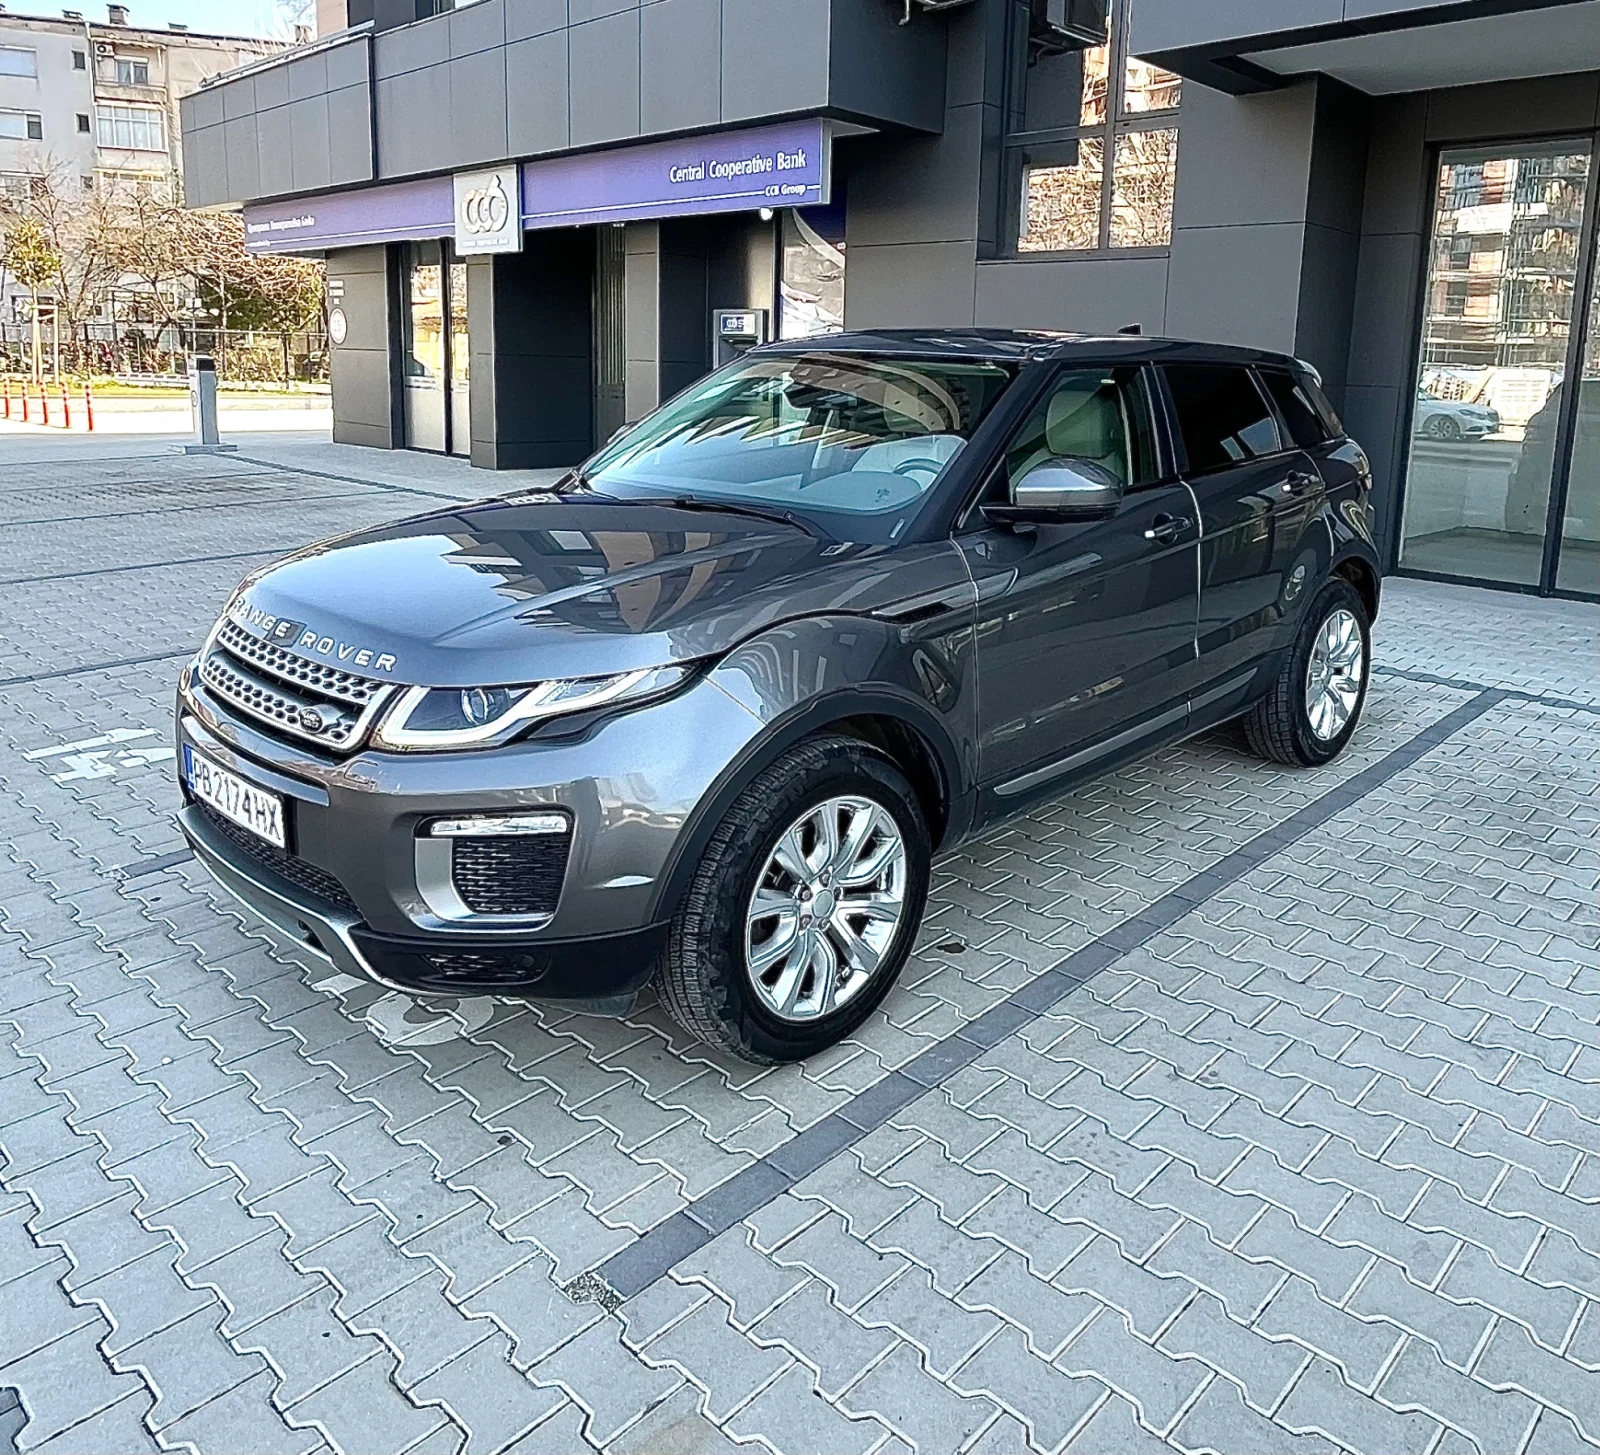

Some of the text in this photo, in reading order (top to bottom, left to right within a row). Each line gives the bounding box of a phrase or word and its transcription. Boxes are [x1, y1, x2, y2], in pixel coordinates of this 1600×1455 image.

[670, 149, 806, 182] Central Cooperative Bank
[781, 184, 806, 195] Group
[233, 597, 397, 672] RANGE ROVER
